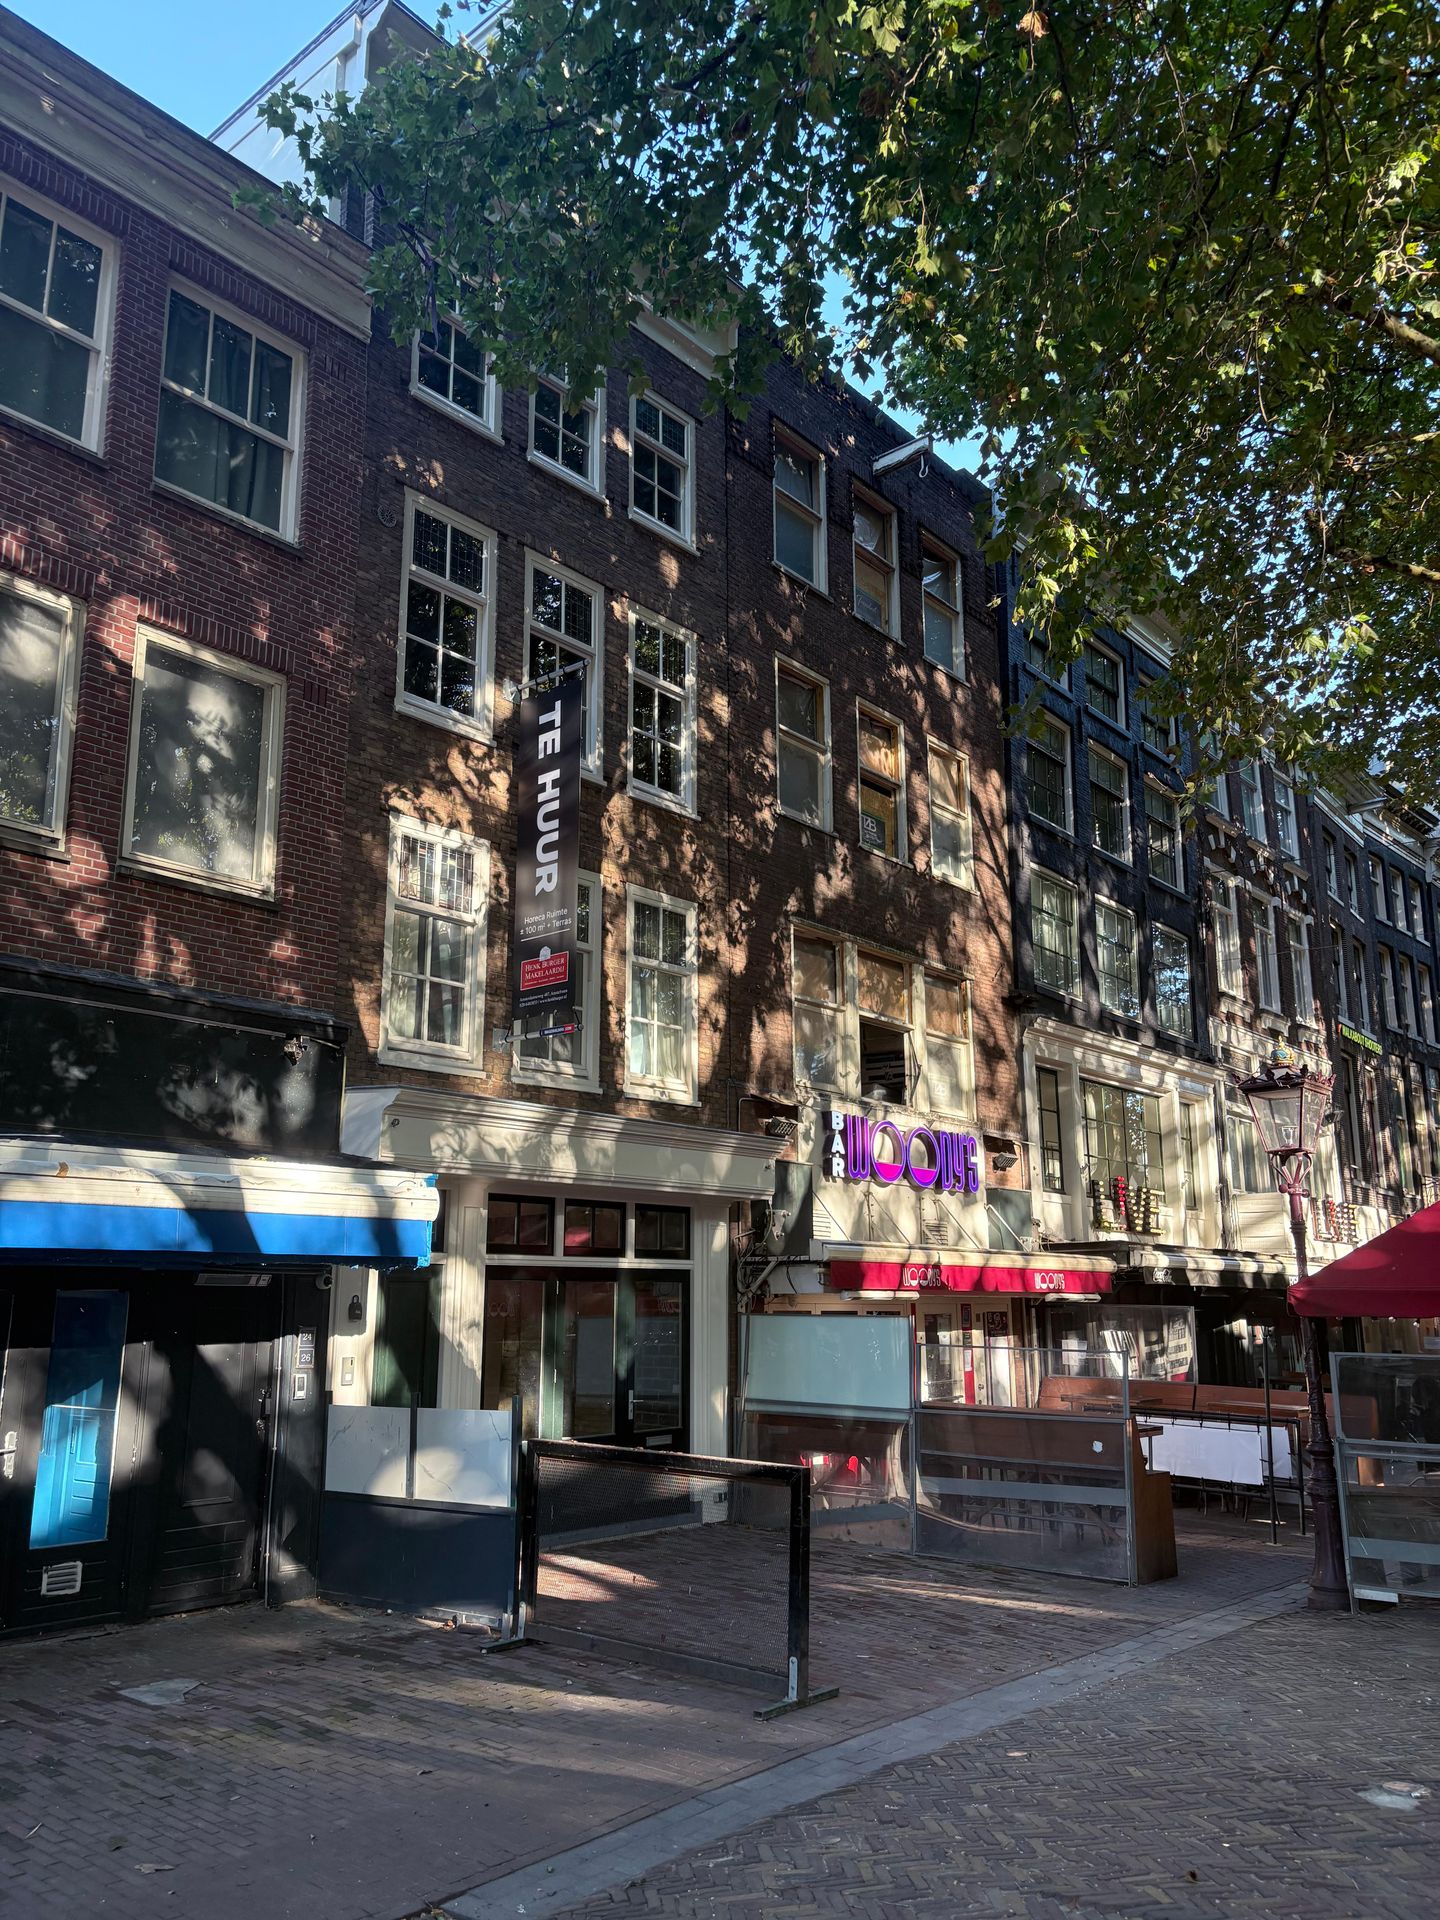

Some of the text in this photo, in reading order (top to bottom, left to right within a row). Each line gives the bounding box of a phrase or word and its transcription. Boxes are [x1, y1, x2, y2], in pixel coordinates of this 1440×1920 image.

[535, 700, 561, 897] TE HUUR
[524, 908, 568, 925] Horeca Ruimte
[525, 925, 537, 935] 100
[552, 918, 572, 928] Terras
[525, 957, 565, 972] HENK BURGER
[831, 1111, 845, 1178] BAR
[301, 1353, 311, 1361] 26
